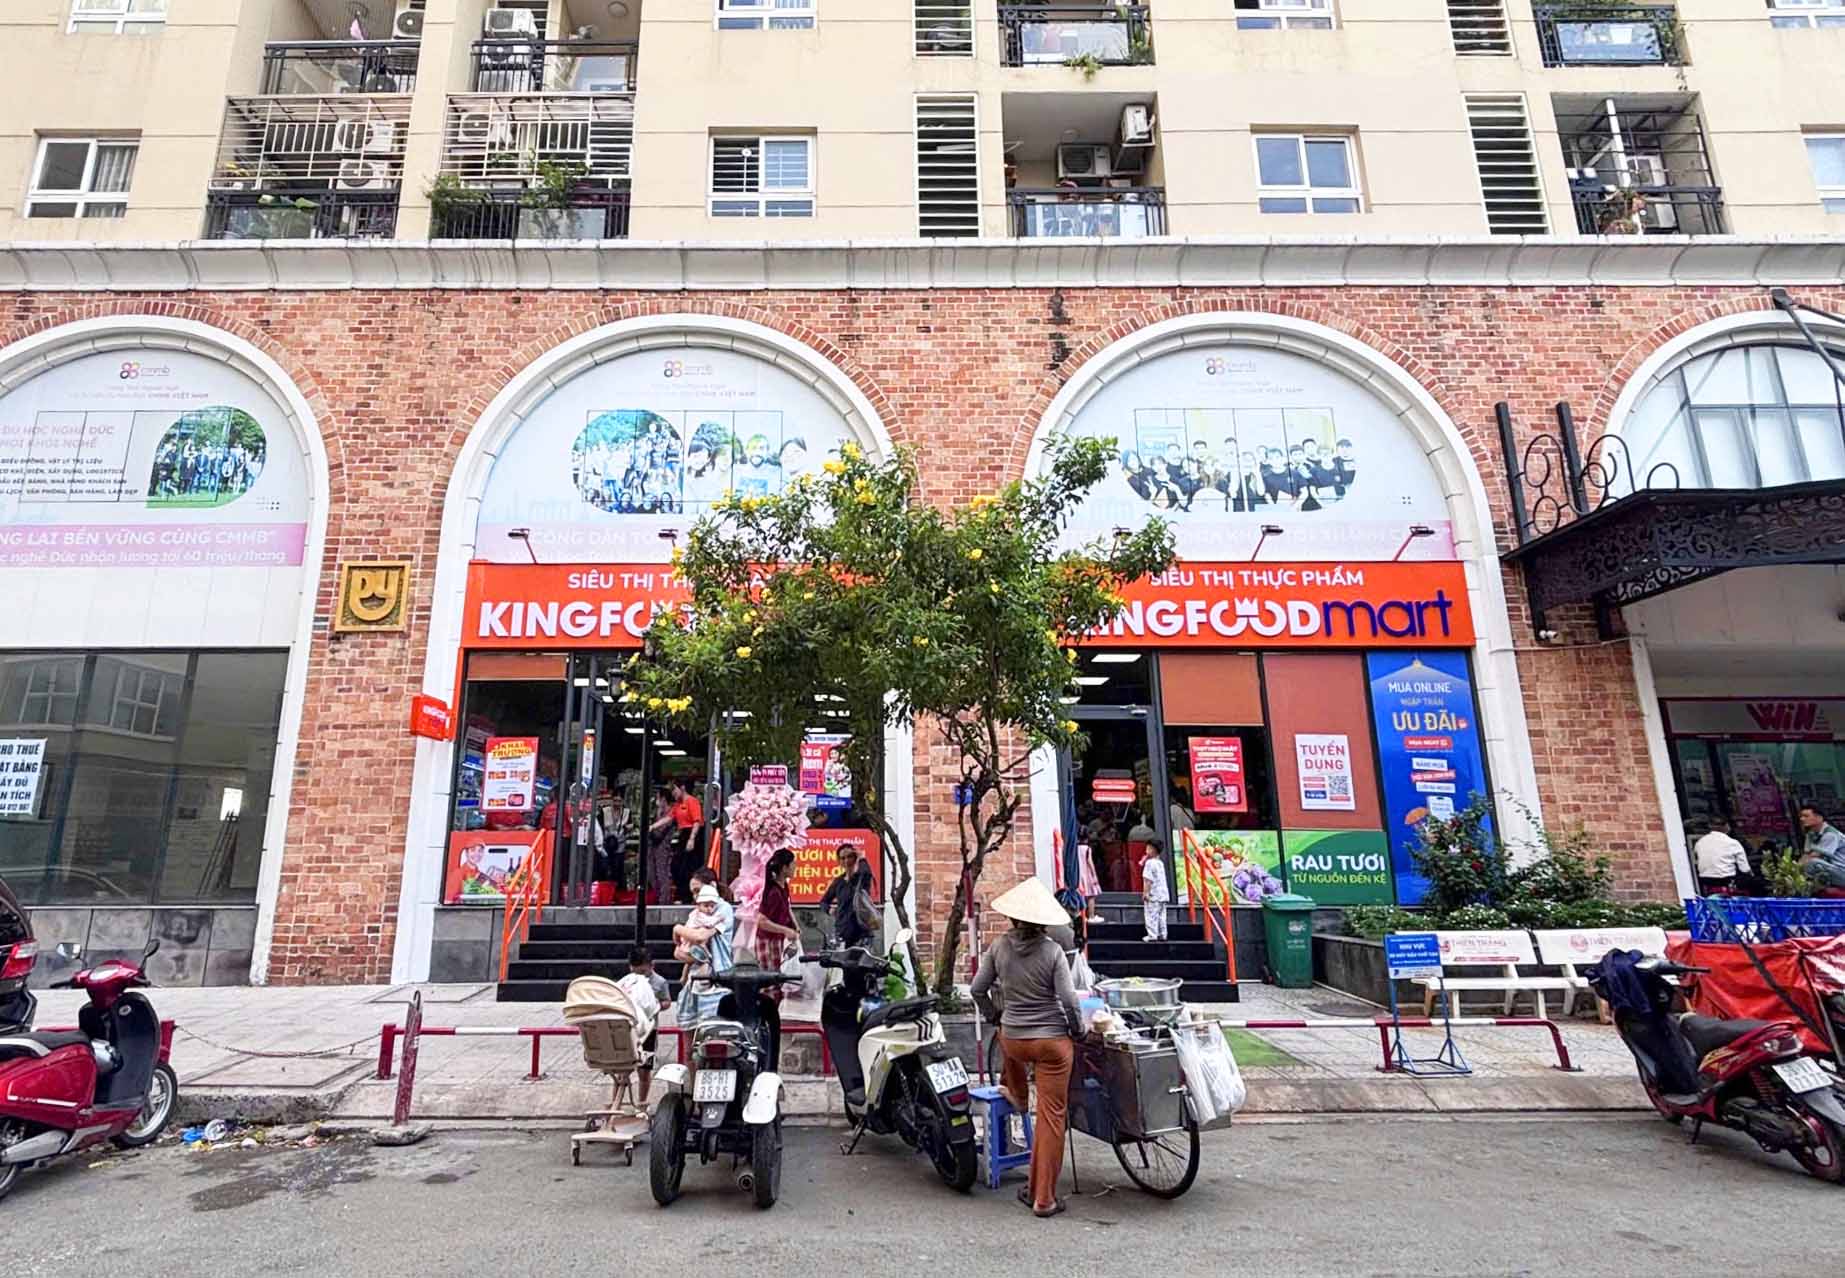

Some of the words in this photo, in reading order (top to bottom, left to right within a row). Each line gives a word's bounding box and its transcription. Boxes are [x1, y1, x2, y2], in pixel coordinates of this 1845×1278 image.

[568, 569, 614, 589] SIÊU
[621, 572, 654, 592] THỊ
[1150, 567, 1195, 587] SIÊU
[1199, 570, 1236, 590] THỊ
[1238, 569, 1297, 590] THỰC
[1302, 565, 1365, 586] PHẨM
[1388, 681, 1412, 693] MUA
[1413, 681, 1452, 693] ONLINE
[1392, 710, 1420, 731] ƯU
[1423, 709, 1457, 731] ĐÃI
[0, 743, 14, 755] HO
[1299, 739, 1345, 756] TUYỂN
[1304, 758, 1344, 773] DỤNG
[792, 848, 823, 861] TƯƠI
[1291, 854, 1333, 872] RAU
[1336, 853, 1386, 872] TƯƠI
[1309, 871, 1348, 884] NGUỒN
[1349, 871, 1372, 884] ĐẾN
[791, 883, 813, 895] TIN
